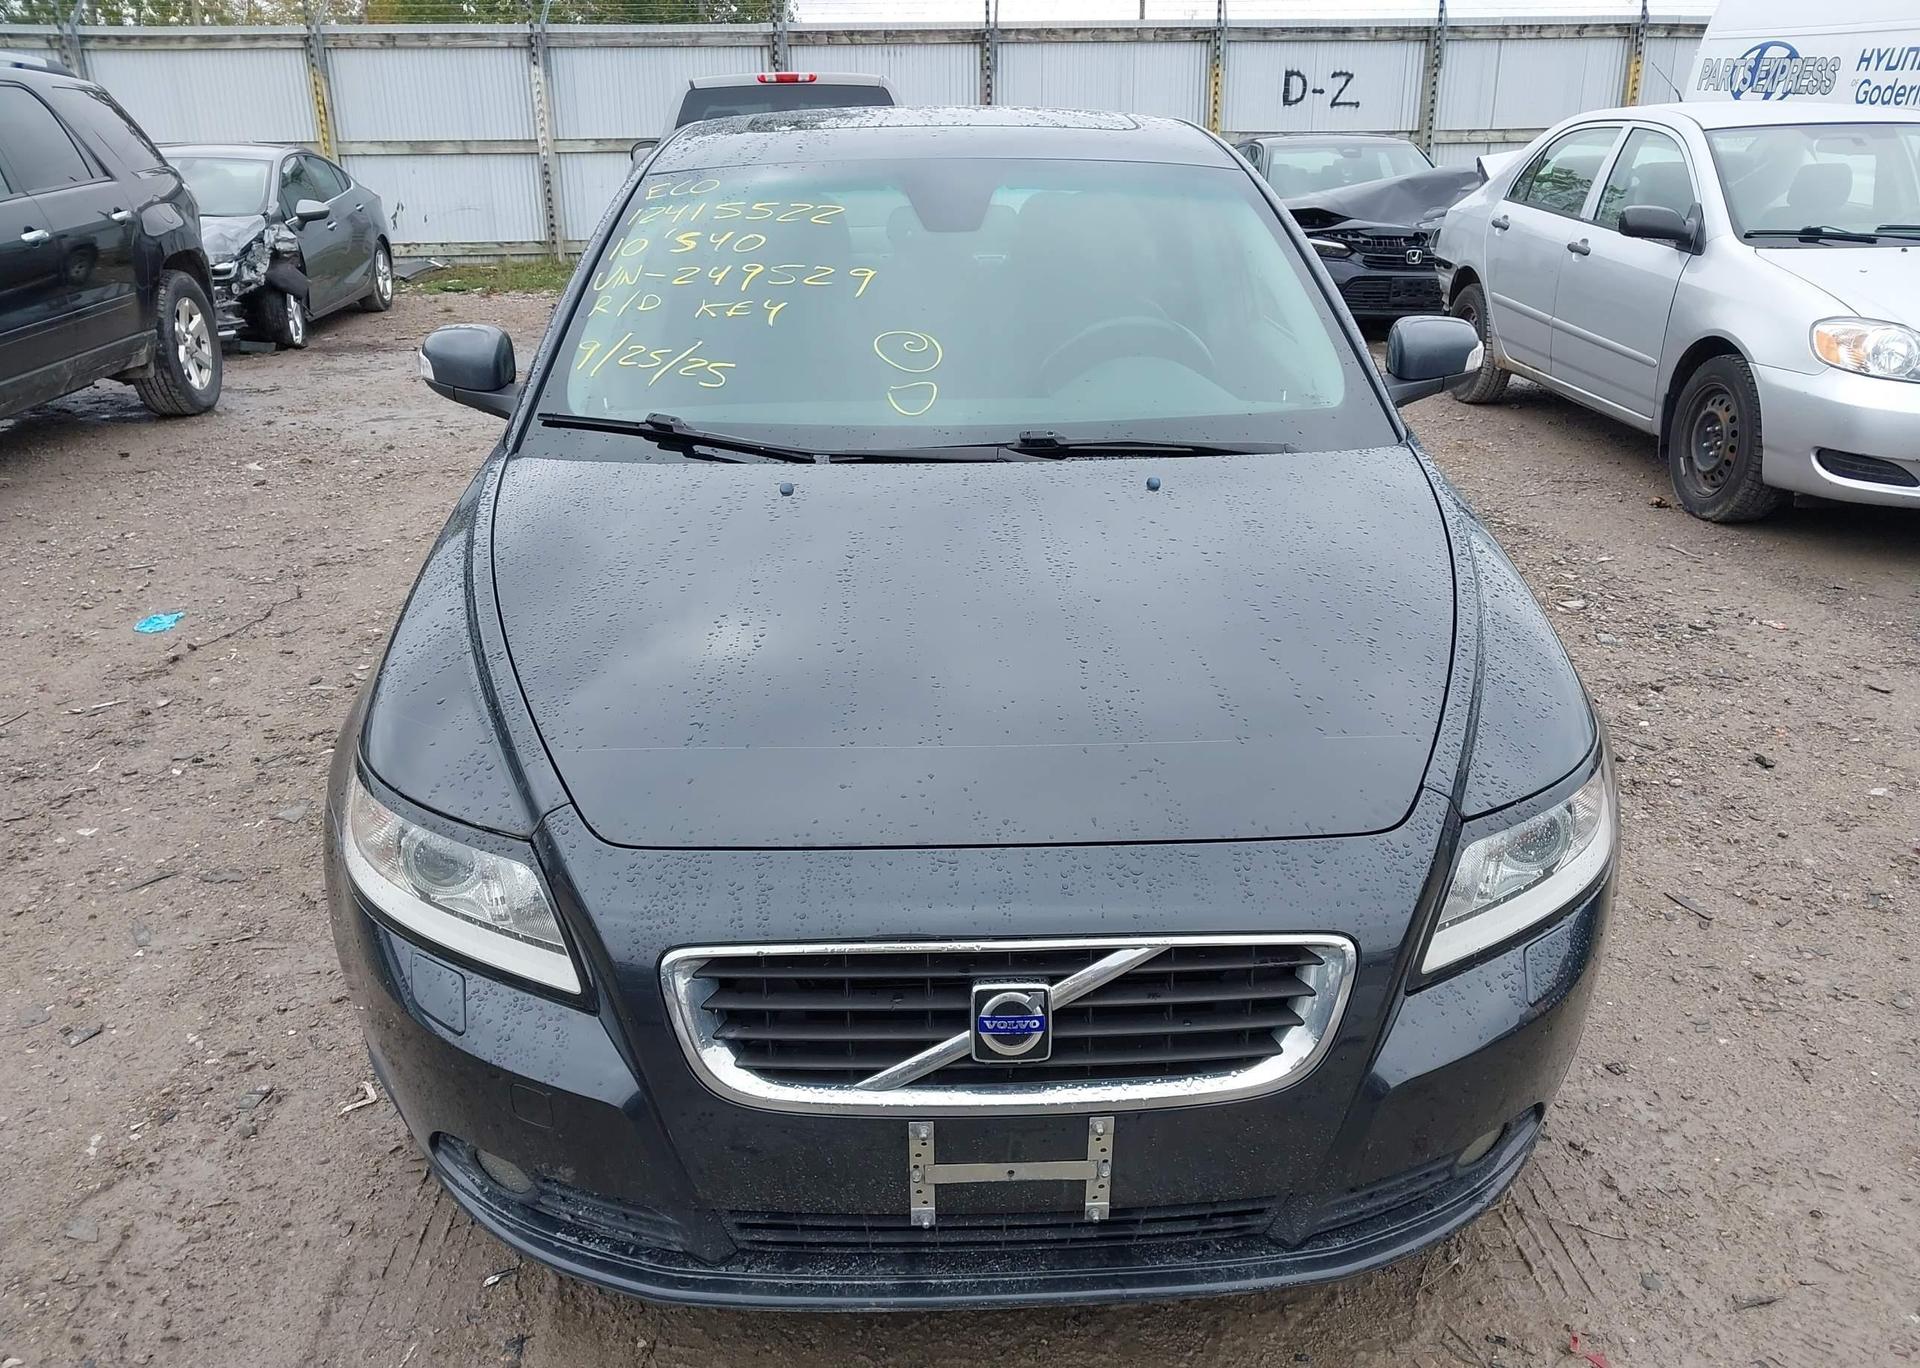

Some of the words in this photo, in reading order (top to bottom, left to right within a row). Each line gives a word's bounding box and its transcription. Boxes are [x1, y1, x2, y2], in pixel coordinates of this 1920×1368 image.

[1856, 46, 1920, 72] HYUN
[1696, 56, 1756, 92] PARTS
[1751, 56, 1842, 96] EXPRESS
[645, 179, 721, 200] ECO
[627, 202, 846, 226] 12415522
[694, 299, 788, 328] KEY
[575, 332, 737, 388] 9/25/25
[983, 1019, 1039, 1029] VOLVO
